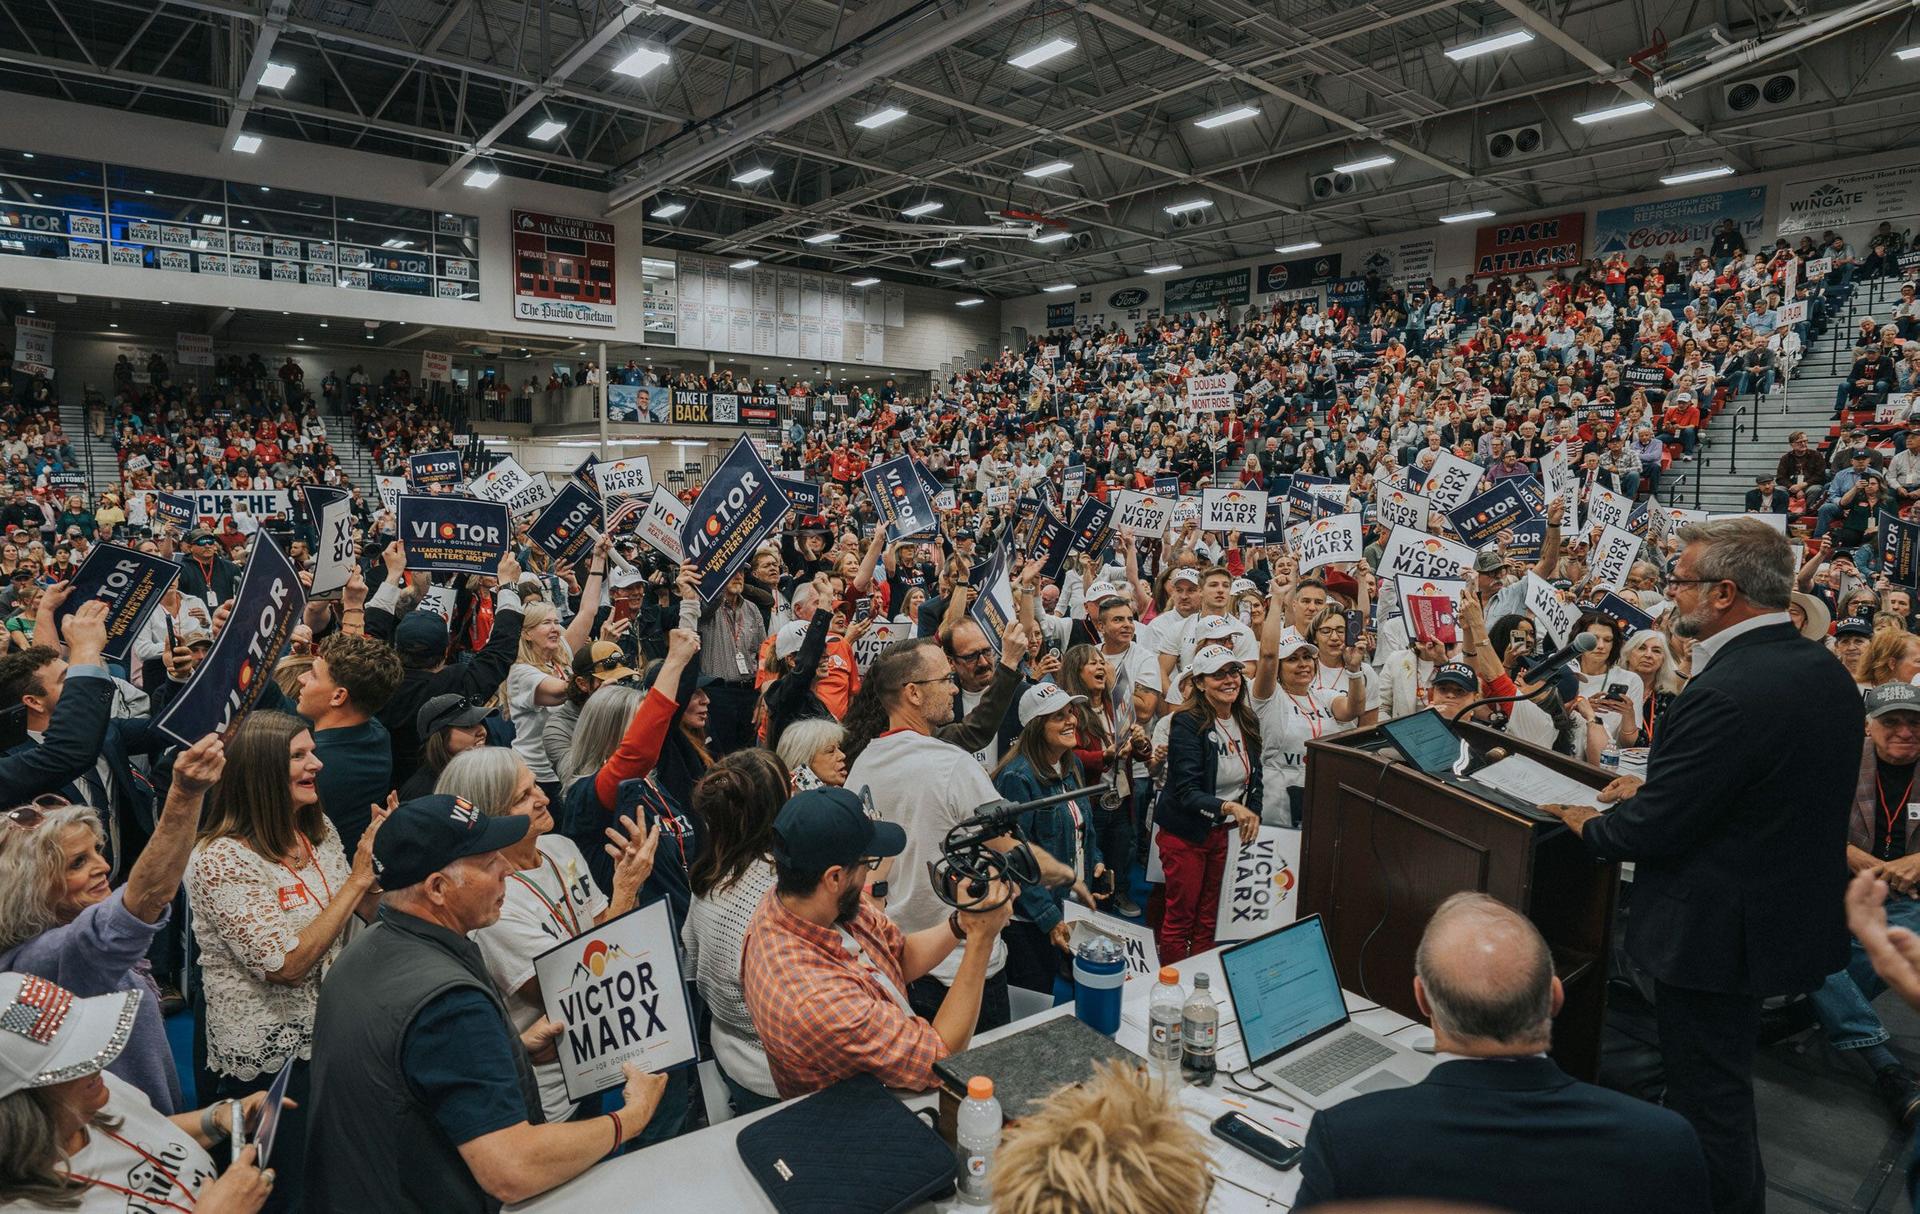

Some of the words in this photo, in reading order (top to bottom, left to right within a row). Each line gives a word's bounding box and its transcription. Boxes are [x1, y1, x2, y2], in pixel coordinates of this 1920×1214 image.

[1837, 173, 1875, 185] Preferred
[1790, 191, 1864, 212] WINGATE
[1633, 201, 1723, 223] REFRESHMENT
[1810, 206, 1851, 218] WYNDHAM
[72, 221, 100, 230] VICTOR
[72, 227, 101, 235] MARX
[130, 228, 158, 236] VICTOR
[540, 222, 580, 240] MASSARI
[582, 229, 612, 242] ARENA
[1496, 220, 1561, 246] PACK
[130, 233, 159, 241] MARX
[162, 231, 190, 239] VICTOR
[162, 236, 191, 244] MARX
[1628, 225, 1690, 250] Coors
[71, 247, 100, 256] VICTOR
[237, 240, 263, 248] VICTOR
[237, 245, 264, 254] MARX
[72, 253, 100, 261] MARX
[112, 250, 140, 259] VICTOR
[113, 256, 141, 264] MARX
[162, 255, 188, 263] VICTOR
[274, 250, 300, 259] MARX
[310, 254, 335, 262] MARX
[518, 249, 547, 259] T-WOLVES
[1477, 243, 1577, 274] ATTACK!
[162, 261, 189, 269] MARX
[200, 259, 226, 267] VICTOR
[200, 263, 228, 272] MARX
[274, 267, 299, 275] VICTOR
[373, 256, 426, 273] VICTOR
[590, 259, 609, 268] GUEST
[232, 268, 258, 276] MARX
[274, 272, 299, 281] MARX
[307, 274, 332, 283] MARX
[1195, 279, 1214, 291] SKIP
[1227, 273, 1248, 286] WAIT
[1327, 280, 1366, 295] VICTOR
[1116, 292, 1142, 308] Ford
[520, 302, 539, 316] The
[540, 303, 573, 319] Pueblo
[575, 308, 613, 323] Chieftain
[1194, 377, 1227, 390] DOUGLAS
[1626, 371, 1664, 381] BOTTOMS
[676, 391, 699, 405] TAKE
[700, 392, 708, 405] IT
[743, 396, 776, 406] VICTOR
[1191, 396, 1210, 410] MONT
[1212, 396, 1230, 409] ROSE
[676, 405, 709, 422] BACK
[415, 462, 457, 474] VICTOR
[602, 469, 643, 482] VICTOR
[51, 475, 85, 484] BOTTOMS
[482, 470, 517, 496] VICTOR
[604, 477, 645, 492] MARX
[488, 476, 523, 502] MARX
[1429, 466, 1459, 511] VICTOR
[510, 491, 547, 511] MARX
[886, 468, 917, 528] VICTOR
[1290, 496, 1312, 510] VICTOR
[1593, 496, 1622, 516] VICTOR
[688, 471, 761, 558] VICTOR
[1125, 503, 1164, 520] VICTOR
[1211, 502, 1257, 513] VICTOR
[1381, 497, 1418, 519] VICTOR
[1461, 496, 1518, 531] VICTOR
[1591, 505, 1620, 526] MARX
[544, 502, 593, 550] VICTOR
[709, 537, 720, 549] FOR
[720, 503, 748, 536] GOVERNOR
[1120, 514, 1161, 530] MARX
[1210, 512, 1257, 524] MARX
[1381, 508, 1416, 530] MARX
[411, 520, 500, 545] VICTOR
[705, 548, 726, 571] LEADER
[723, 540, 731, 549] TO
[730, 513, 754, 541] PROTECT
[752, 495, 768, 514] WHAT
[1076, 508, 1108, 549] VICTOR
[450, 539, 482, 547] GOVERNOR
[713, 536, 743, 572] MATTERS
[742, 512, 763, 537] MOST
[1303, 529, 1352, 550] VICTOR
[424, 552, 464, 562] MATTERS
[465, 555, 487, 563] MOST
[454, 549, 482, 557] PROTECT
[482, 551, 497, 559] WHAT
[1305, 540, 1353, 562] MARX
[1600, 537, 1623, 578] VICTOR
[1884, 523, 1900, 576] VICTOR
[1399, 544, 1459, 573] VICTOR
[1607, 540, 1632, 584] MARX
[112, 580, 135, 609] GOVERNOR
[115, 602, 141, 636] MATTERS
[137, 580, 155, 601] MOST
[1537, 585, 1568, 627] VICTOR
[1534, 594, 1566, 639] MARX
[1836, 617, 1865, 627] VICTOR
[215, 577, 289, 734] VICTOR
[1441, 661, 1473, 679] VICTOR
[1231, 840, 1256, 923] MARX
[1252, 839, 1274, 922] VICTOR
[558, 961, 658, 1026] VICTOR
[568, 993, 667, 1065] MARX
[596, 1059, 608, 1071] FOR
[610, 1048, 645, 1066] GOVERNOR
